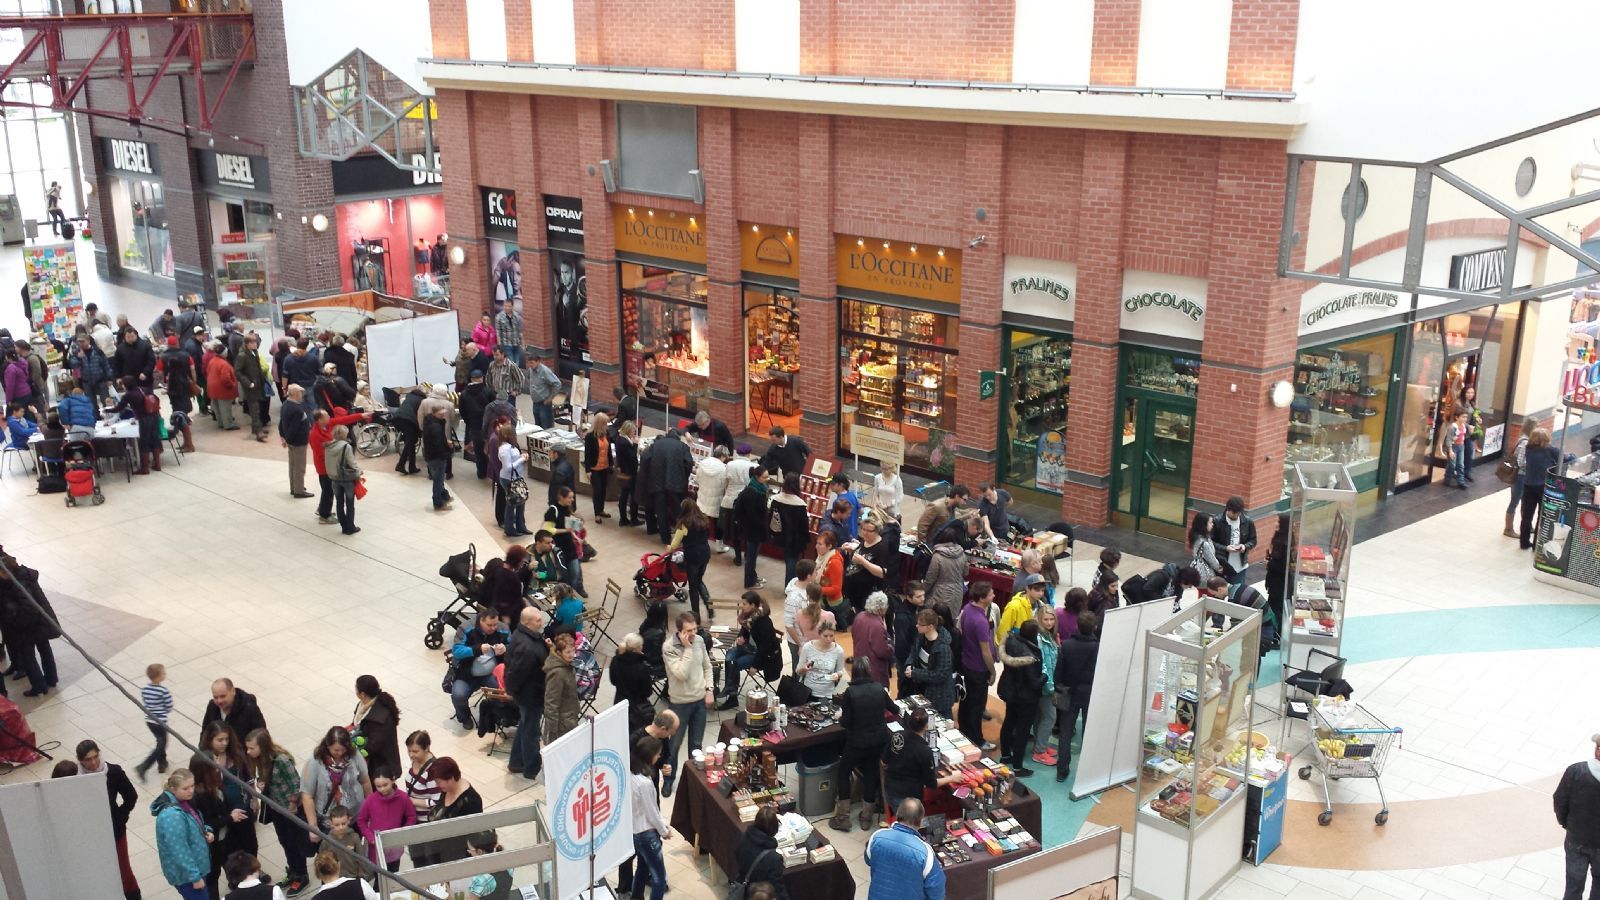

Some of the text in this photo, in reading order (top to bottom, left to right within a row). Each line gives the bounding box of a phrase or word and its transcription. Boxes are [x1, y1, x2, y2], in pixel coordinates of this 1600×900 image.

[111, 138, 152, 174] DIESEL
[216, 153, 254, 183] DIESEL
[490, 216, 517, 229] SILVER
[546, 206, 584, 220] OPRAV
[624, 220, 704, 246] L'OCCITANE
[850, 252, 955, 284] L'OCCITANE
[1010, 277, 1070, 302] PRALINES
[1124, 291, 1204, 322] CHOCOLATE
[1306, 291, 1399, 326] CHOCOLATE PRALINES
